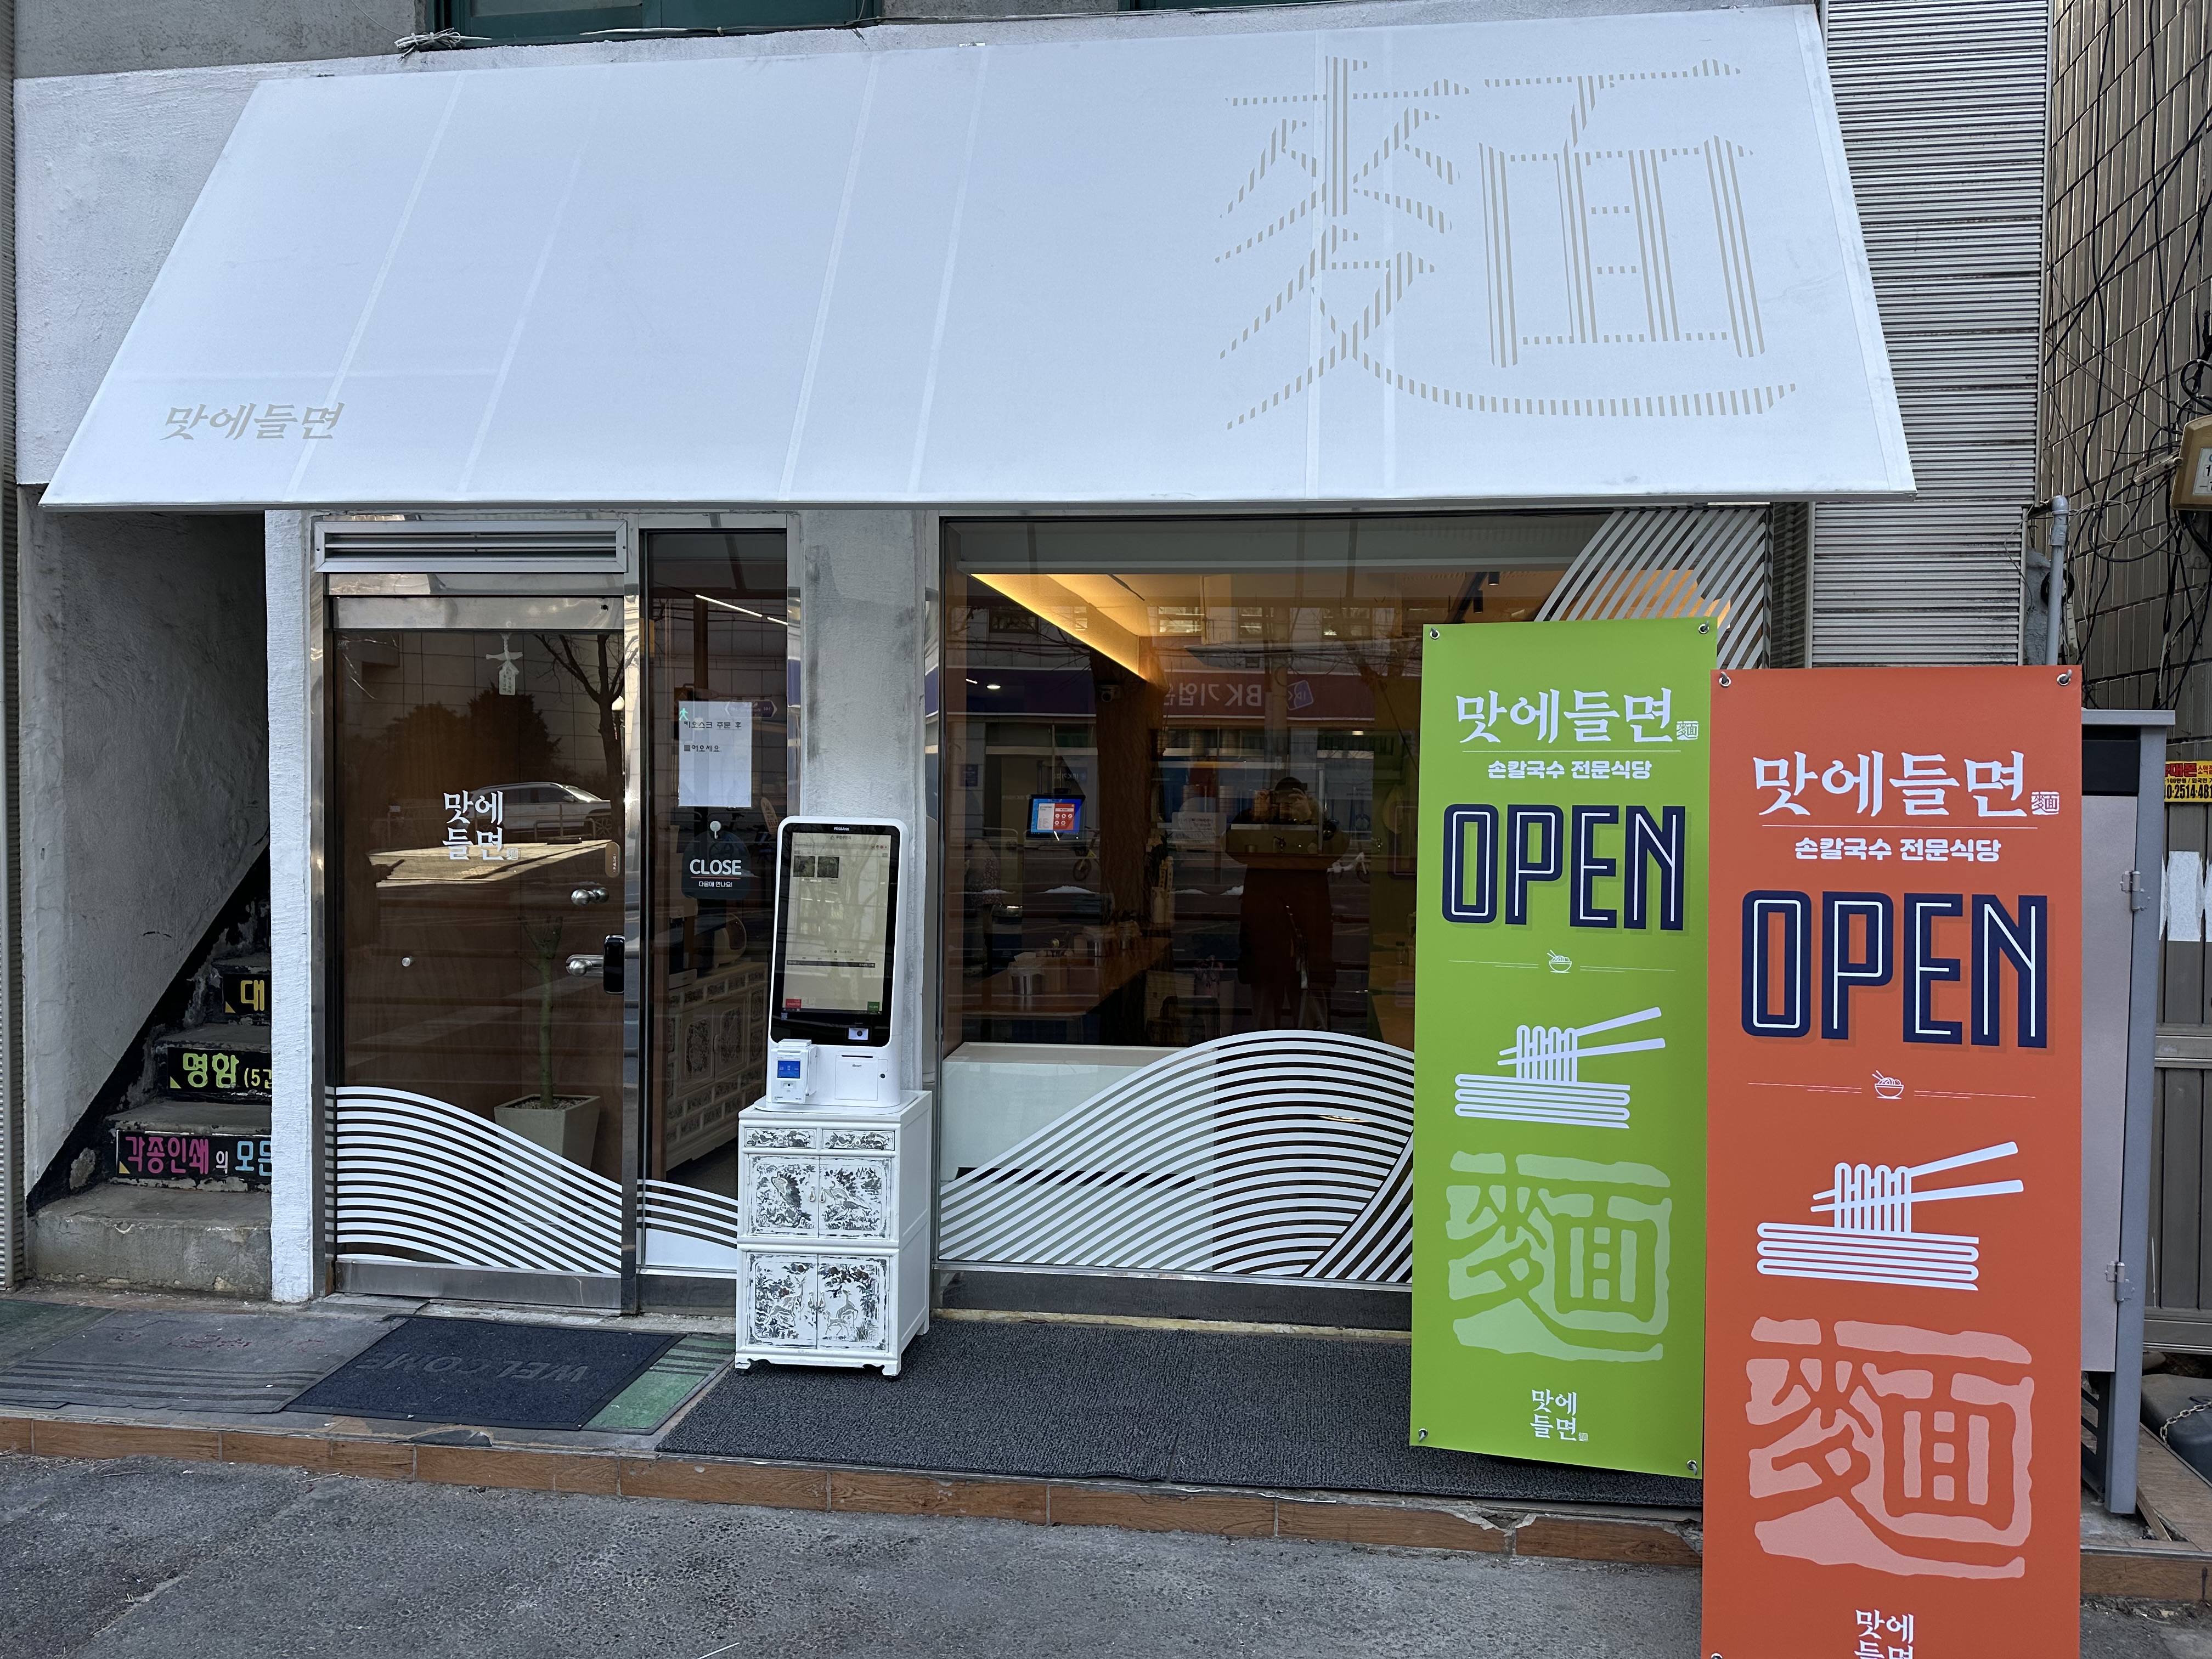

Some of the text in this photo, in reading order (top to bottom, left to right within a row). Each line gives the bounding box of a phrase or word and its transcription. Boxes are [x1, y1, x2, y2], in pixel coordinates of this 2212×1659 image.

[159, 402, 345, 440] 맛에들면
[1456, 687, 1673, 743] 맛에들면
[1488, 760, 1652, 780] 손칼국수 전문식당
[1753, 750, 2027, 817] 맛에들면
[443, 790, 503, 825] 맛에
[442, 827, 504, 860] 들면
[1795, 837, 2002, 862] 손칼국수 전문식당
[690, 859, 742, 875] CLOSE
[1442, 804, 1686, 931] OPEN
[1741, 890, 2047, 1048] OPEN
[240, 980, 264, 1011] 대
[125, 1136, 209, 1175] 각종인쇄
[216, 1151, 228, 1174] 의
[1531, 1389, 1577, 1416] 맛에
[1530, 1413, 1577, 1441] 들면
[1855, 1609, 1914, 1644] 맛에
